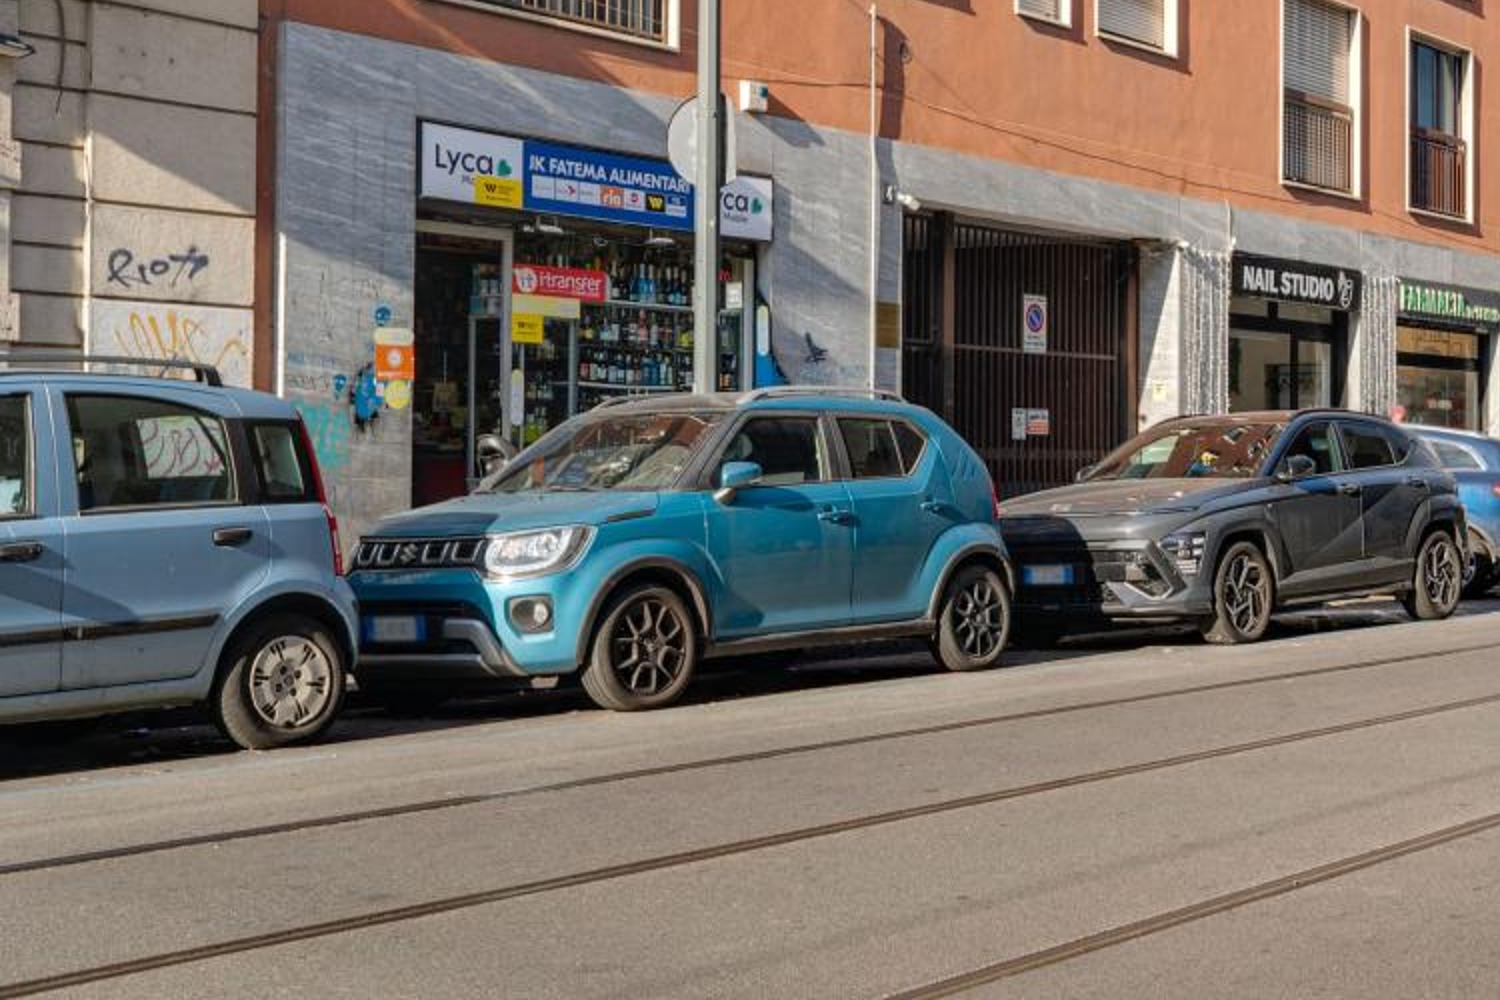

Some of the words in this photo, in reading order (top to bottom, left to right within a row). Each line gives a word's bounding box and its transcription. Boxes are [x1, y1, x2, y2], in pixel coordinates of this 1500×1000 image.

[435, 143, 493, 175] Lyca
[549, 157, 608, 181] FATEMA
[1243, 265, 1279, 293] NAIL
[1280, 271, 1335, 301] STUDIO
